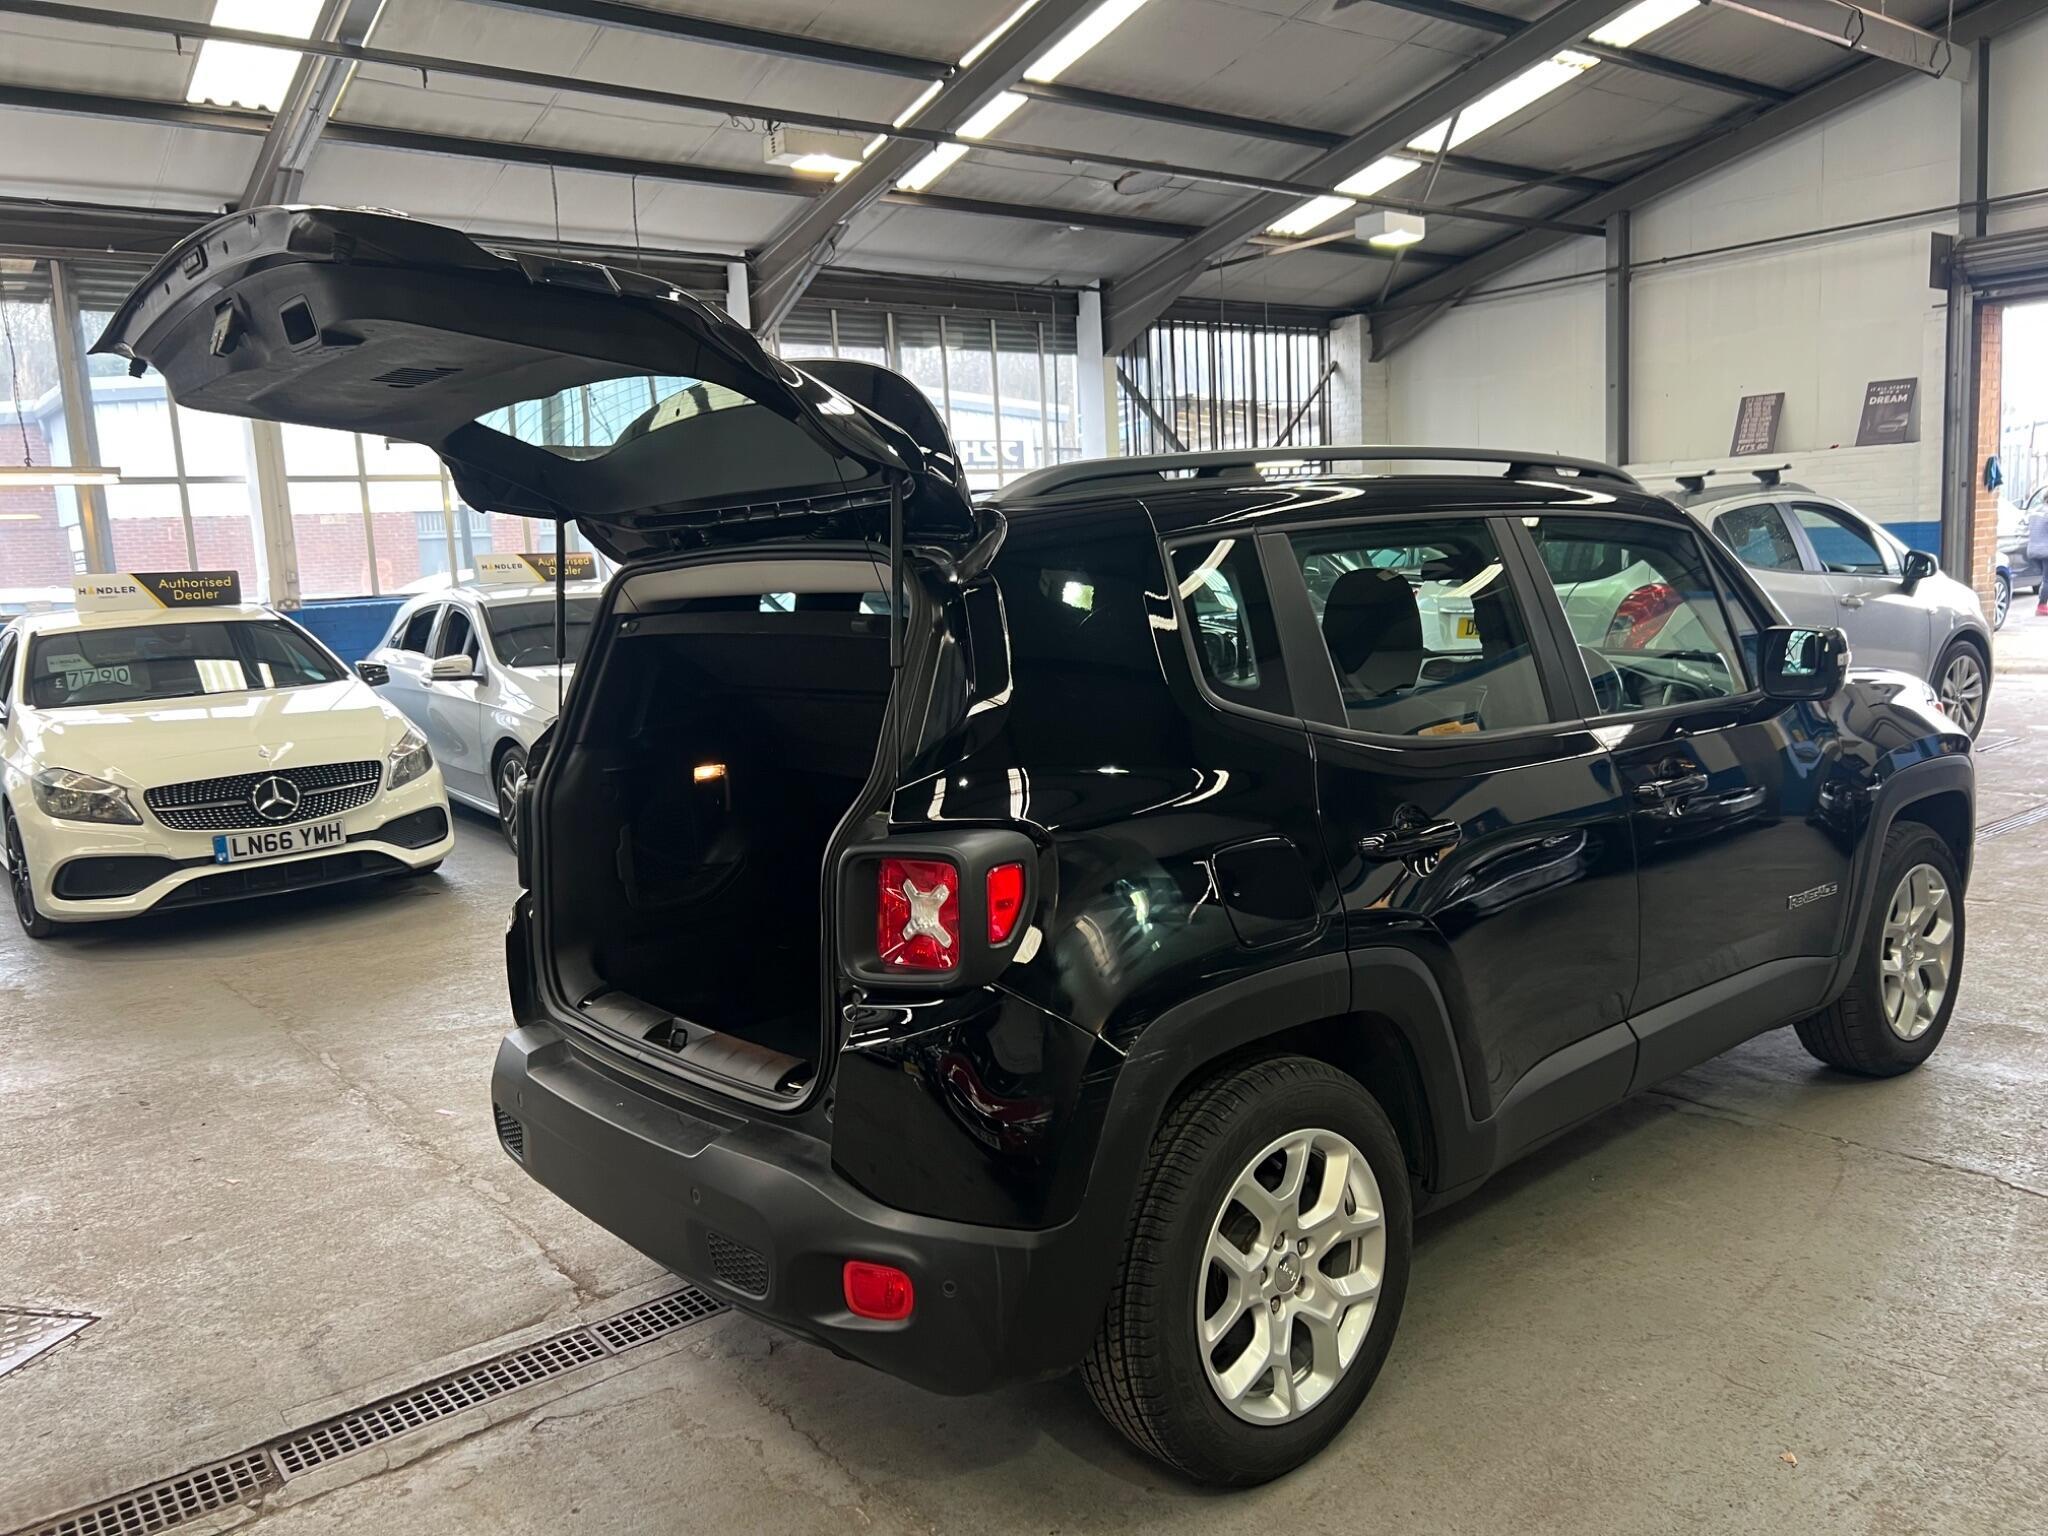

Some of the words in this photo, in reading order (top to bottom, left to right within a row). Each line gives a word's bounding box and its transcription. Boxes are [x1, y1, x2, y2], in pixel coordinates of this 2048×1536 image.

[1869, 394, 1908, 404] DREAM
[549, 566, 582, 576] Daler
[158, 575, 232, 589] Authorised
[78, 586, 137, 596] HANDLER
[174, 589, 219, 601] Dealer
[231, 831, 294, 857] LN66
[299, 822, 342, 846] YMH
